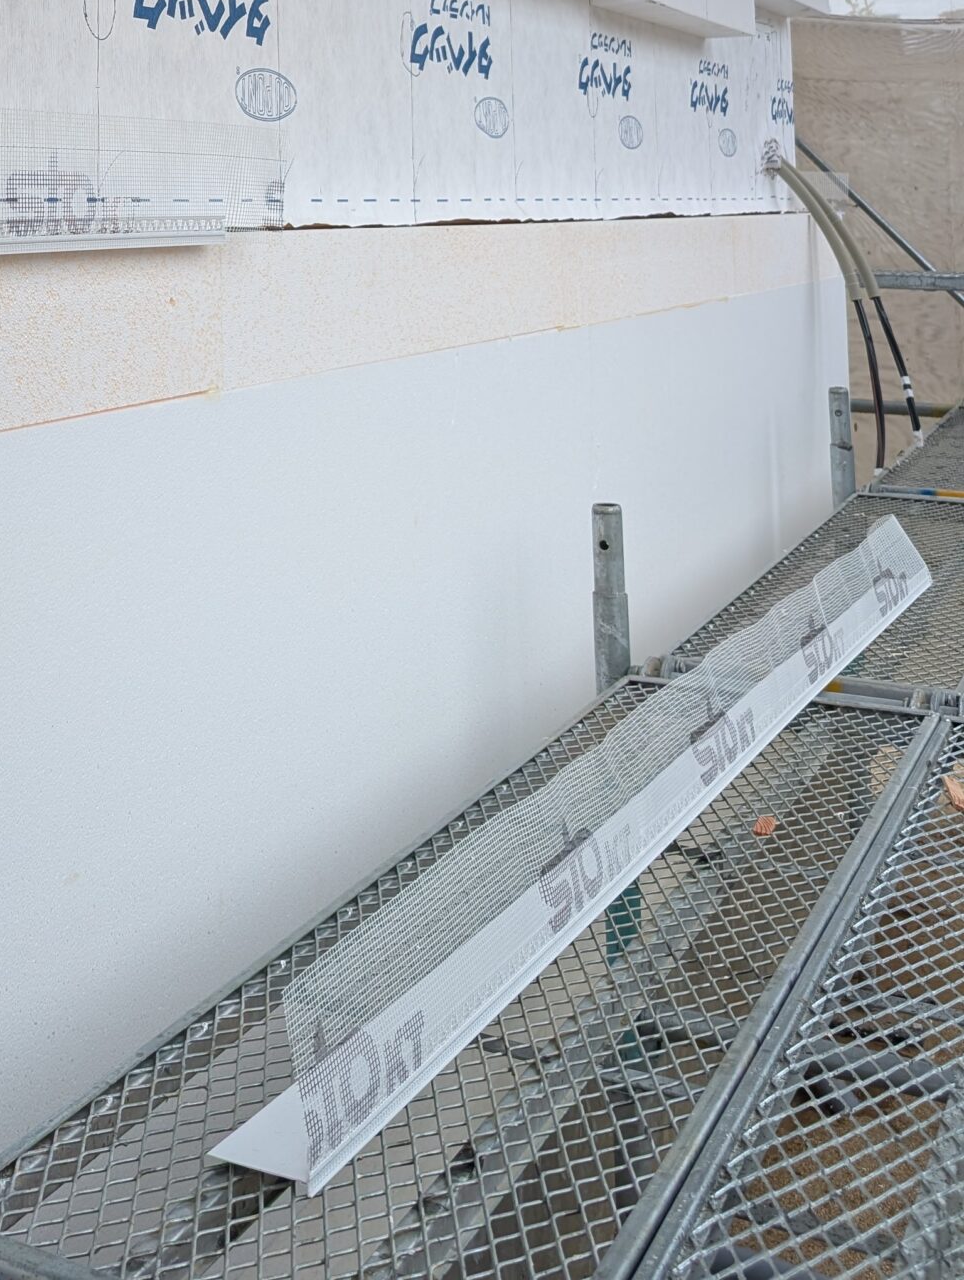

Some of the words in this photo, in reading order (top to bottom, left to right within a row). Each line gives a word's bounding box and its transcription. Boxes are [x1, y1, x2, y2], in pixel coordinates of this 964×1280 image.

[409, 22, 493, 80] タイベック
